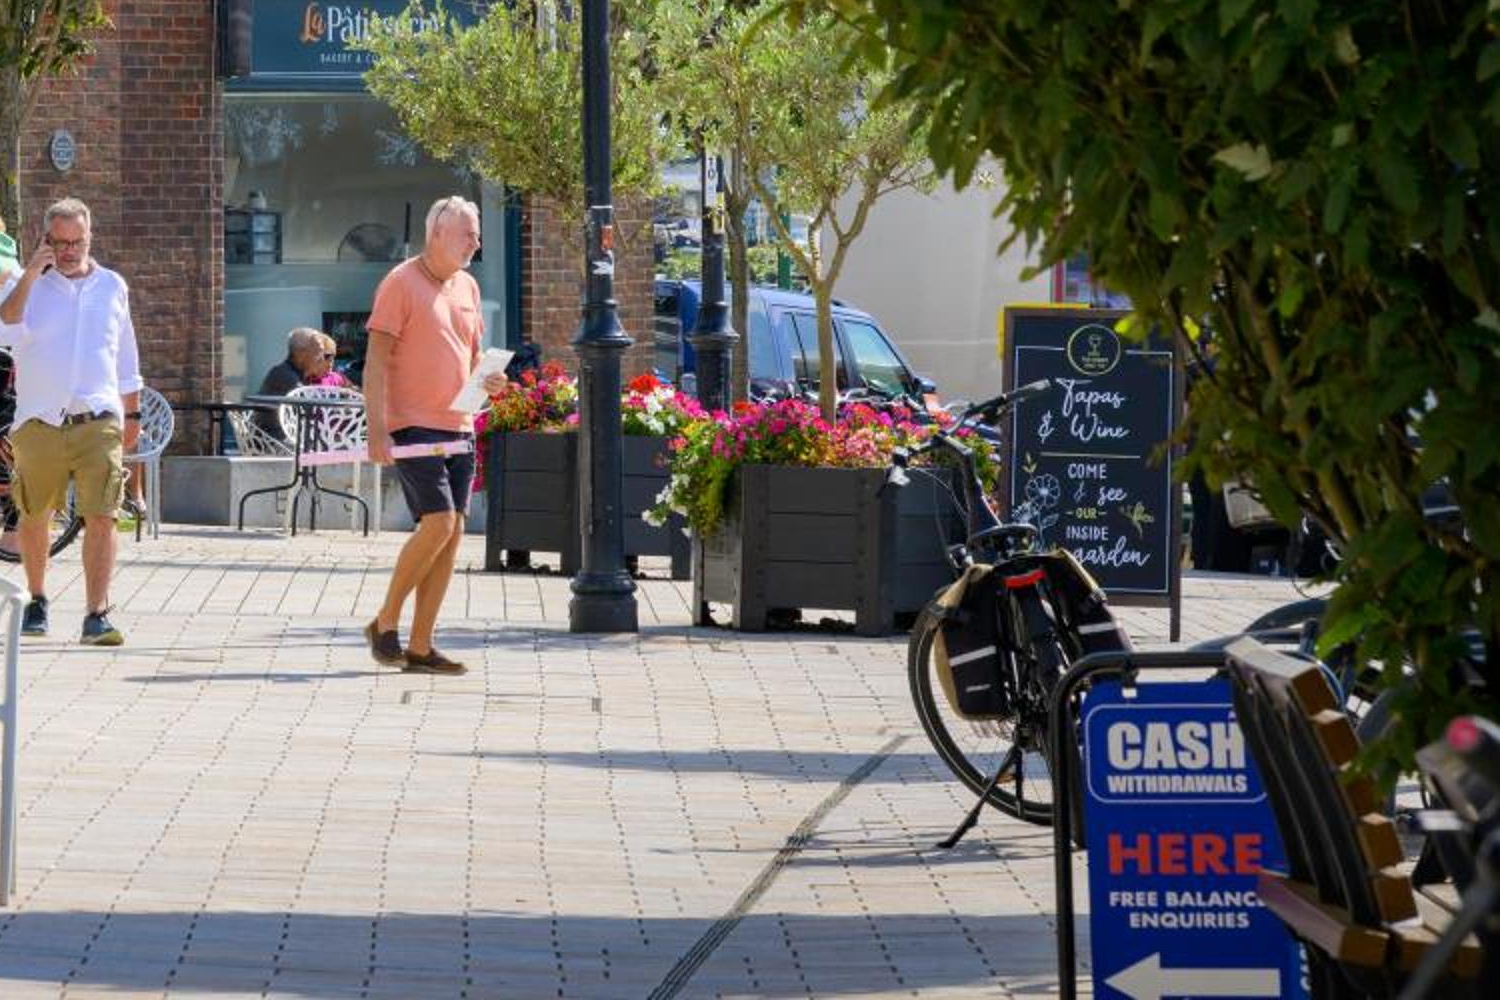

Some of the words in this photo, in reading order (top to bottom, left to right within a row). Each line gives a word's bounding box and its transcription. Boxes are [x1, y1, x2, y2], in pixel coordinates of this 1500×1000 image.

[1056, 378, 1125, 418] Tapas
[1038, 410, 1055, 444] &
[1070, 412, 1130, 442] Wine
[1067, 463, 1108, 479] COME
[1097, 486, 1127, 506] see
[1075, 507, 1098, 519] OUR
[1066, 526, 1109, 541] INSIDE
[1107, 721, 1246, 770] CASH
[1107, 775, 1248, 793] WITHDRAWALS
[1108, 834, 1263, 876] HERE
[1109, 891, 1159, 907] FREE
[1166, 891, 1266, 907] BALANC
[1129, 913, 1250, 929] ENQUIRIES
